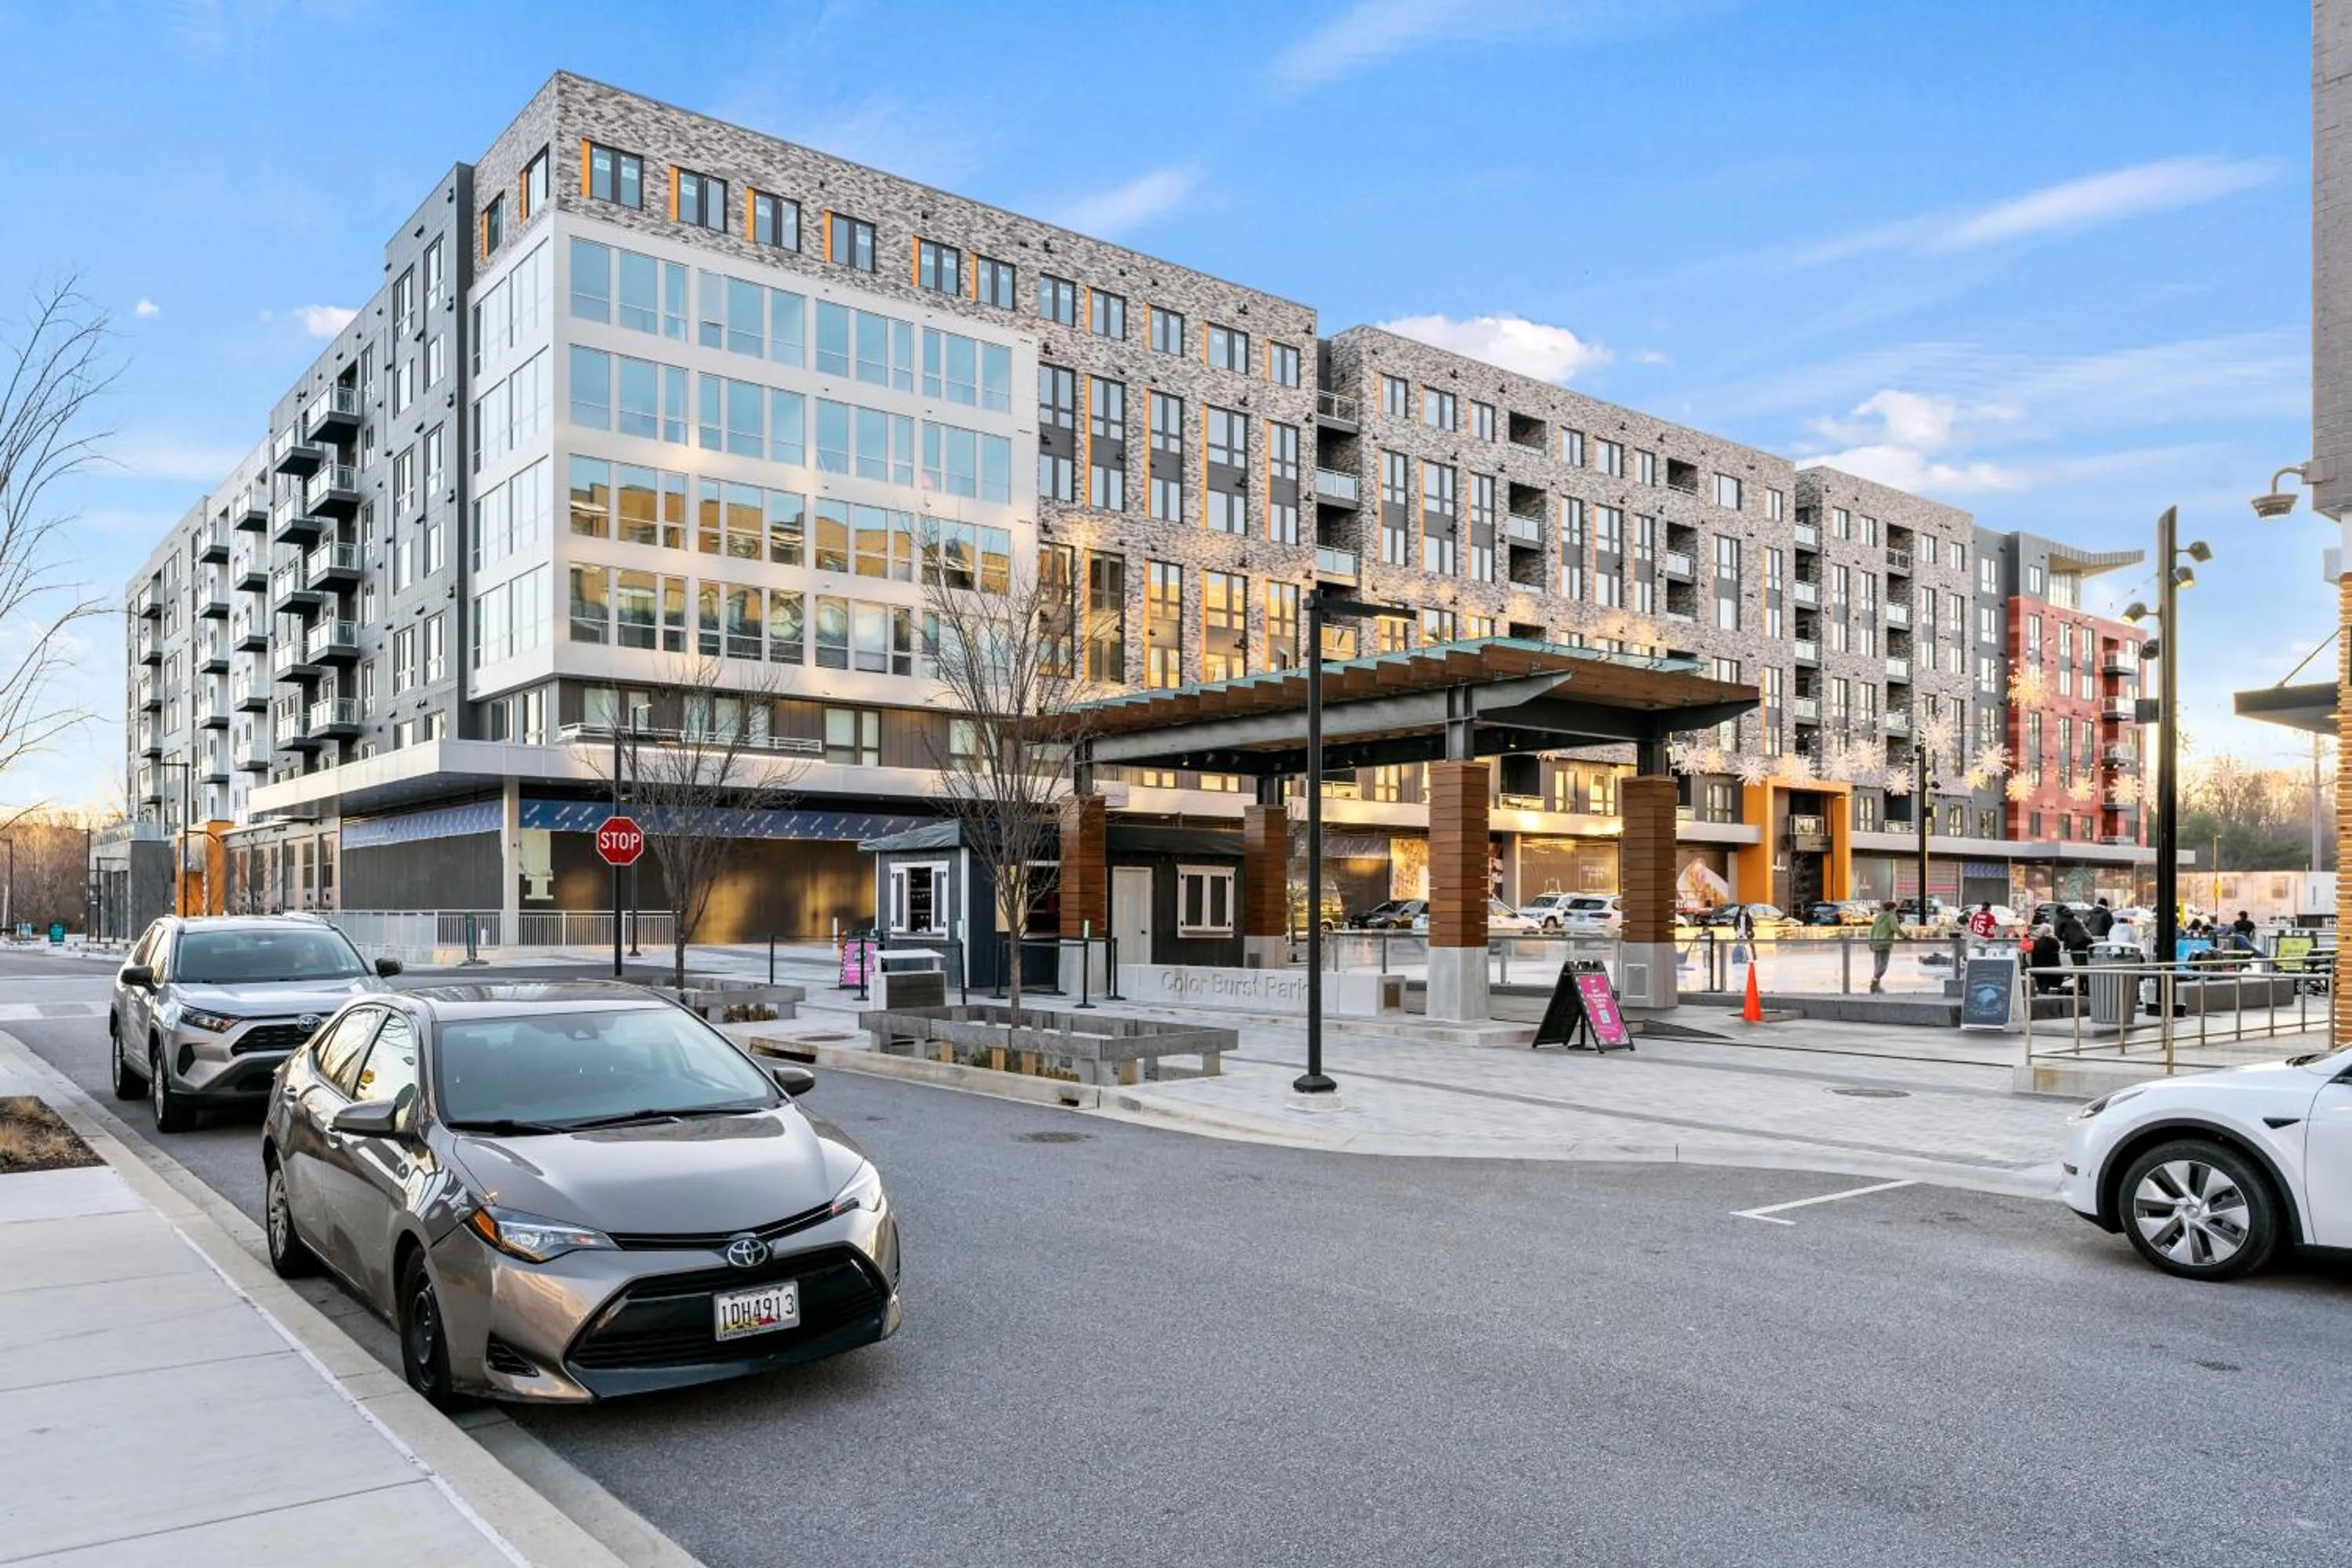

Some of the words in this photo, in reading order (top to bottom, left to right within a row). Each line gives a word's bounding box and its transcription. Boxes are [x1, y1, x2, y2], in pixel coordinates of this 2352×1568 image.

[600, 832, 641, 850] STOP
[1973, 920, 1987, 933] 15
[1161, 971, 1207, 995] Color
[1211, 973, 1258, 997] Burst
[722, 1293, 794, 1329] 1DH4913
